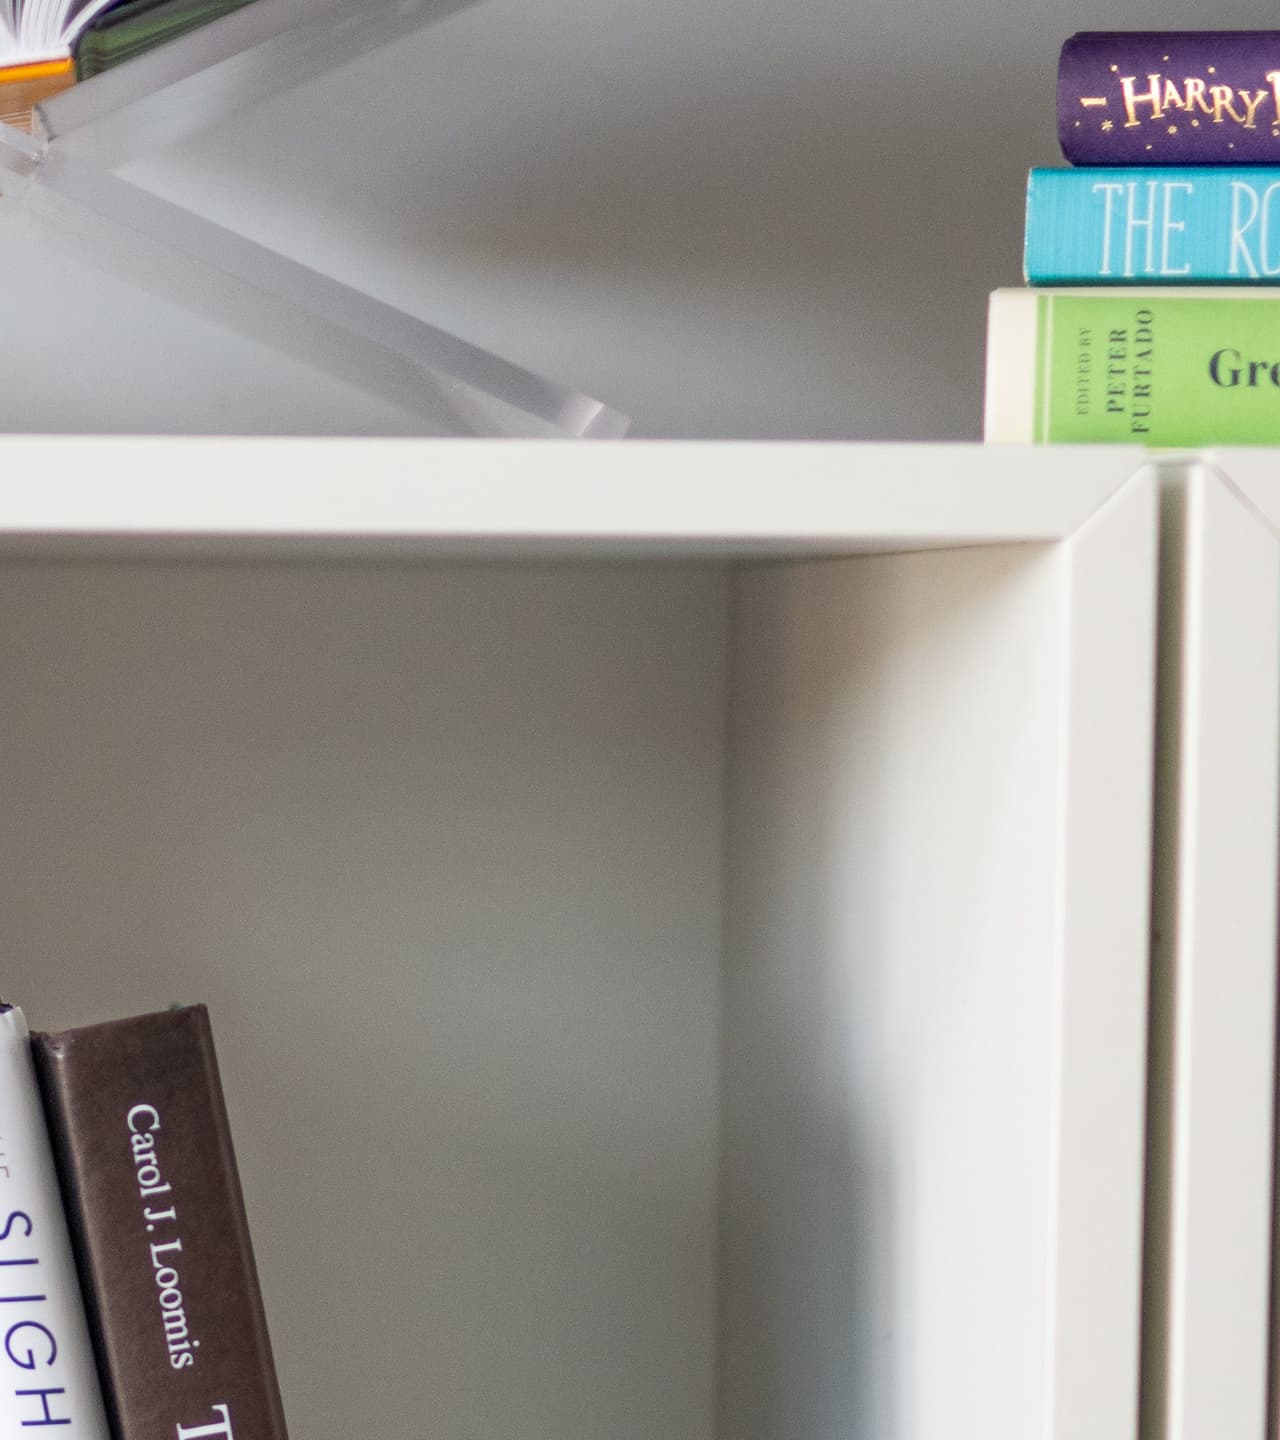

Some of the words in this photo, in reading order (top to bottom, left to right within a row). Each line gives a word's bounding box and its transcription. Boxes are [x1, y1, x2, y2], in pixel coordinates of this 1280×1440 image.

[1121, 73, 1268, 128] HARRY
[1092, 182, 1193, 277] THE
[1106, 329, 1128, 414] PETER
[1132, 309, 1154, 434] FURTADO
[127, 1104, 171, 1198] Carol
[145, 1207, 177, 1232] J.
[150, 1239, 201, 1369] Loomis
